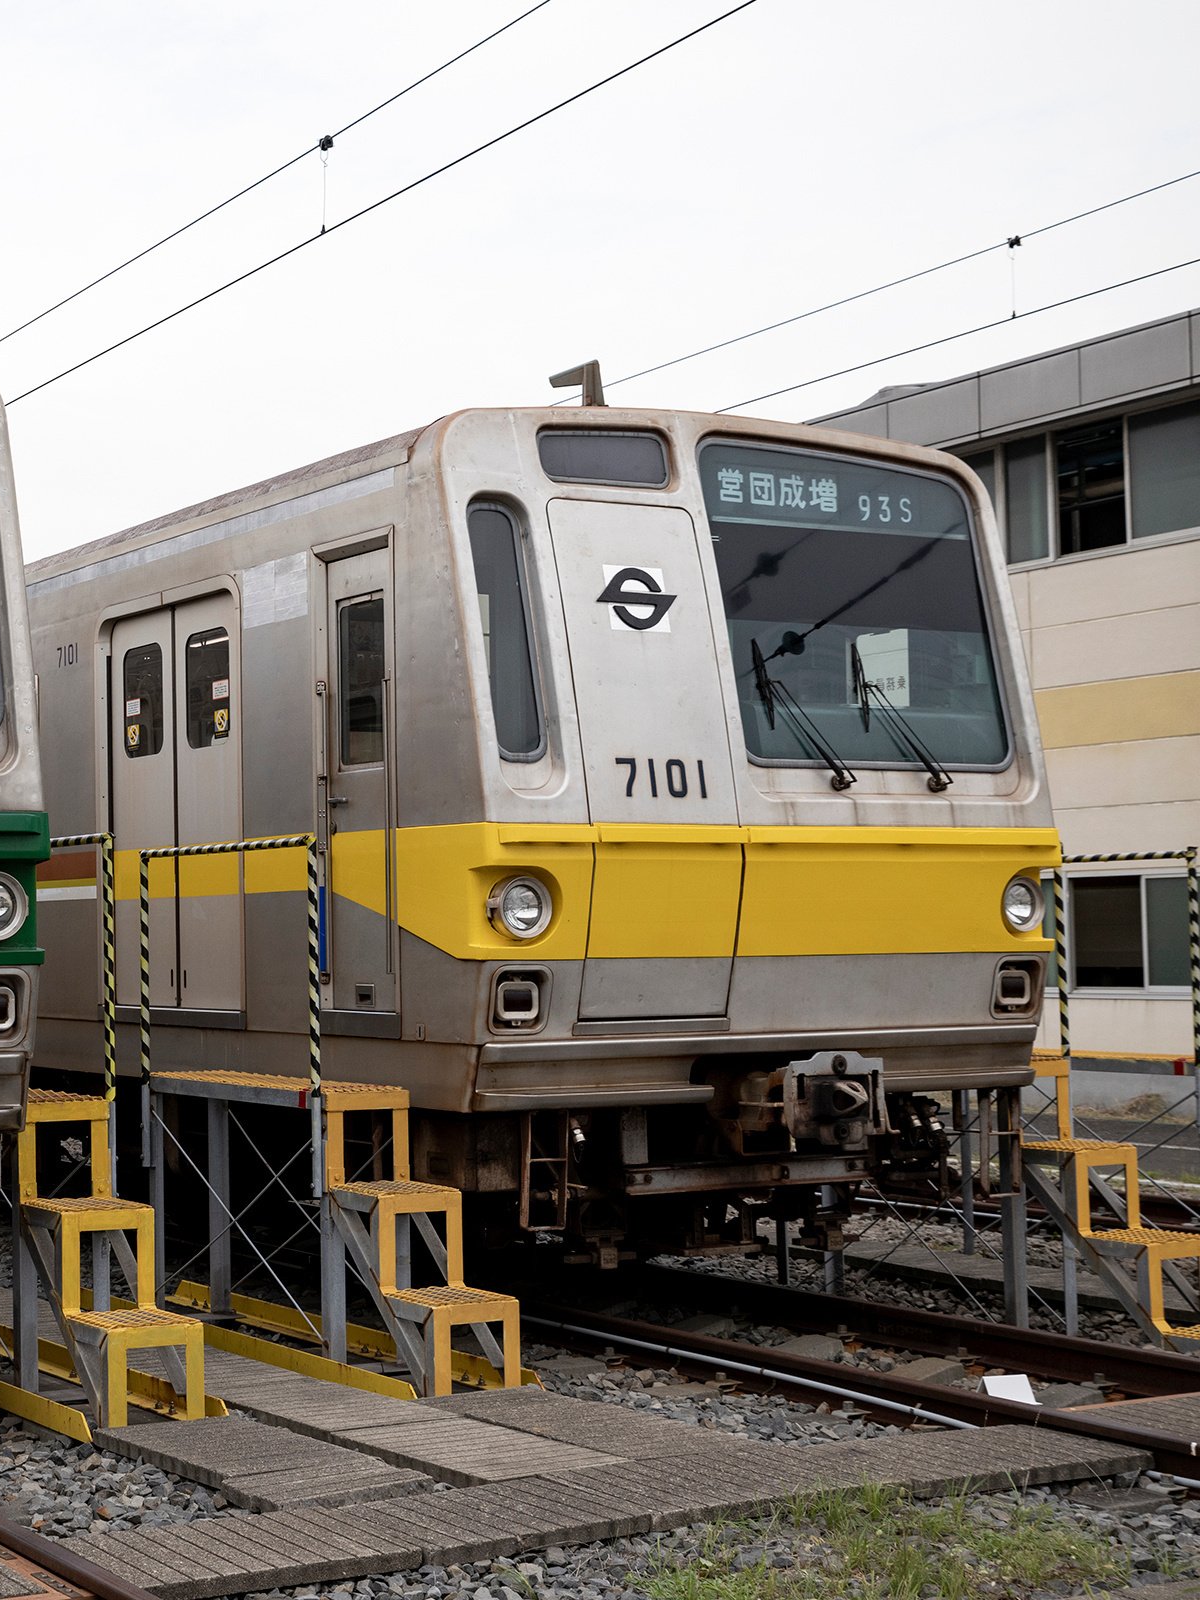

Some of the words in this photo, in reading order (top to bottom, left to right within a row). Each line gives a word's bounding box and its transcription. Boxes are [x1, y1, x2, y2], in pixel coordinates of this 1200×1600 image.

[717, 468, 839, 513] 営団成増
[858, 495, 912, 523] 93S
[56, 642, 79, 669] 7101
[615, 757, 707, 799] 7101
